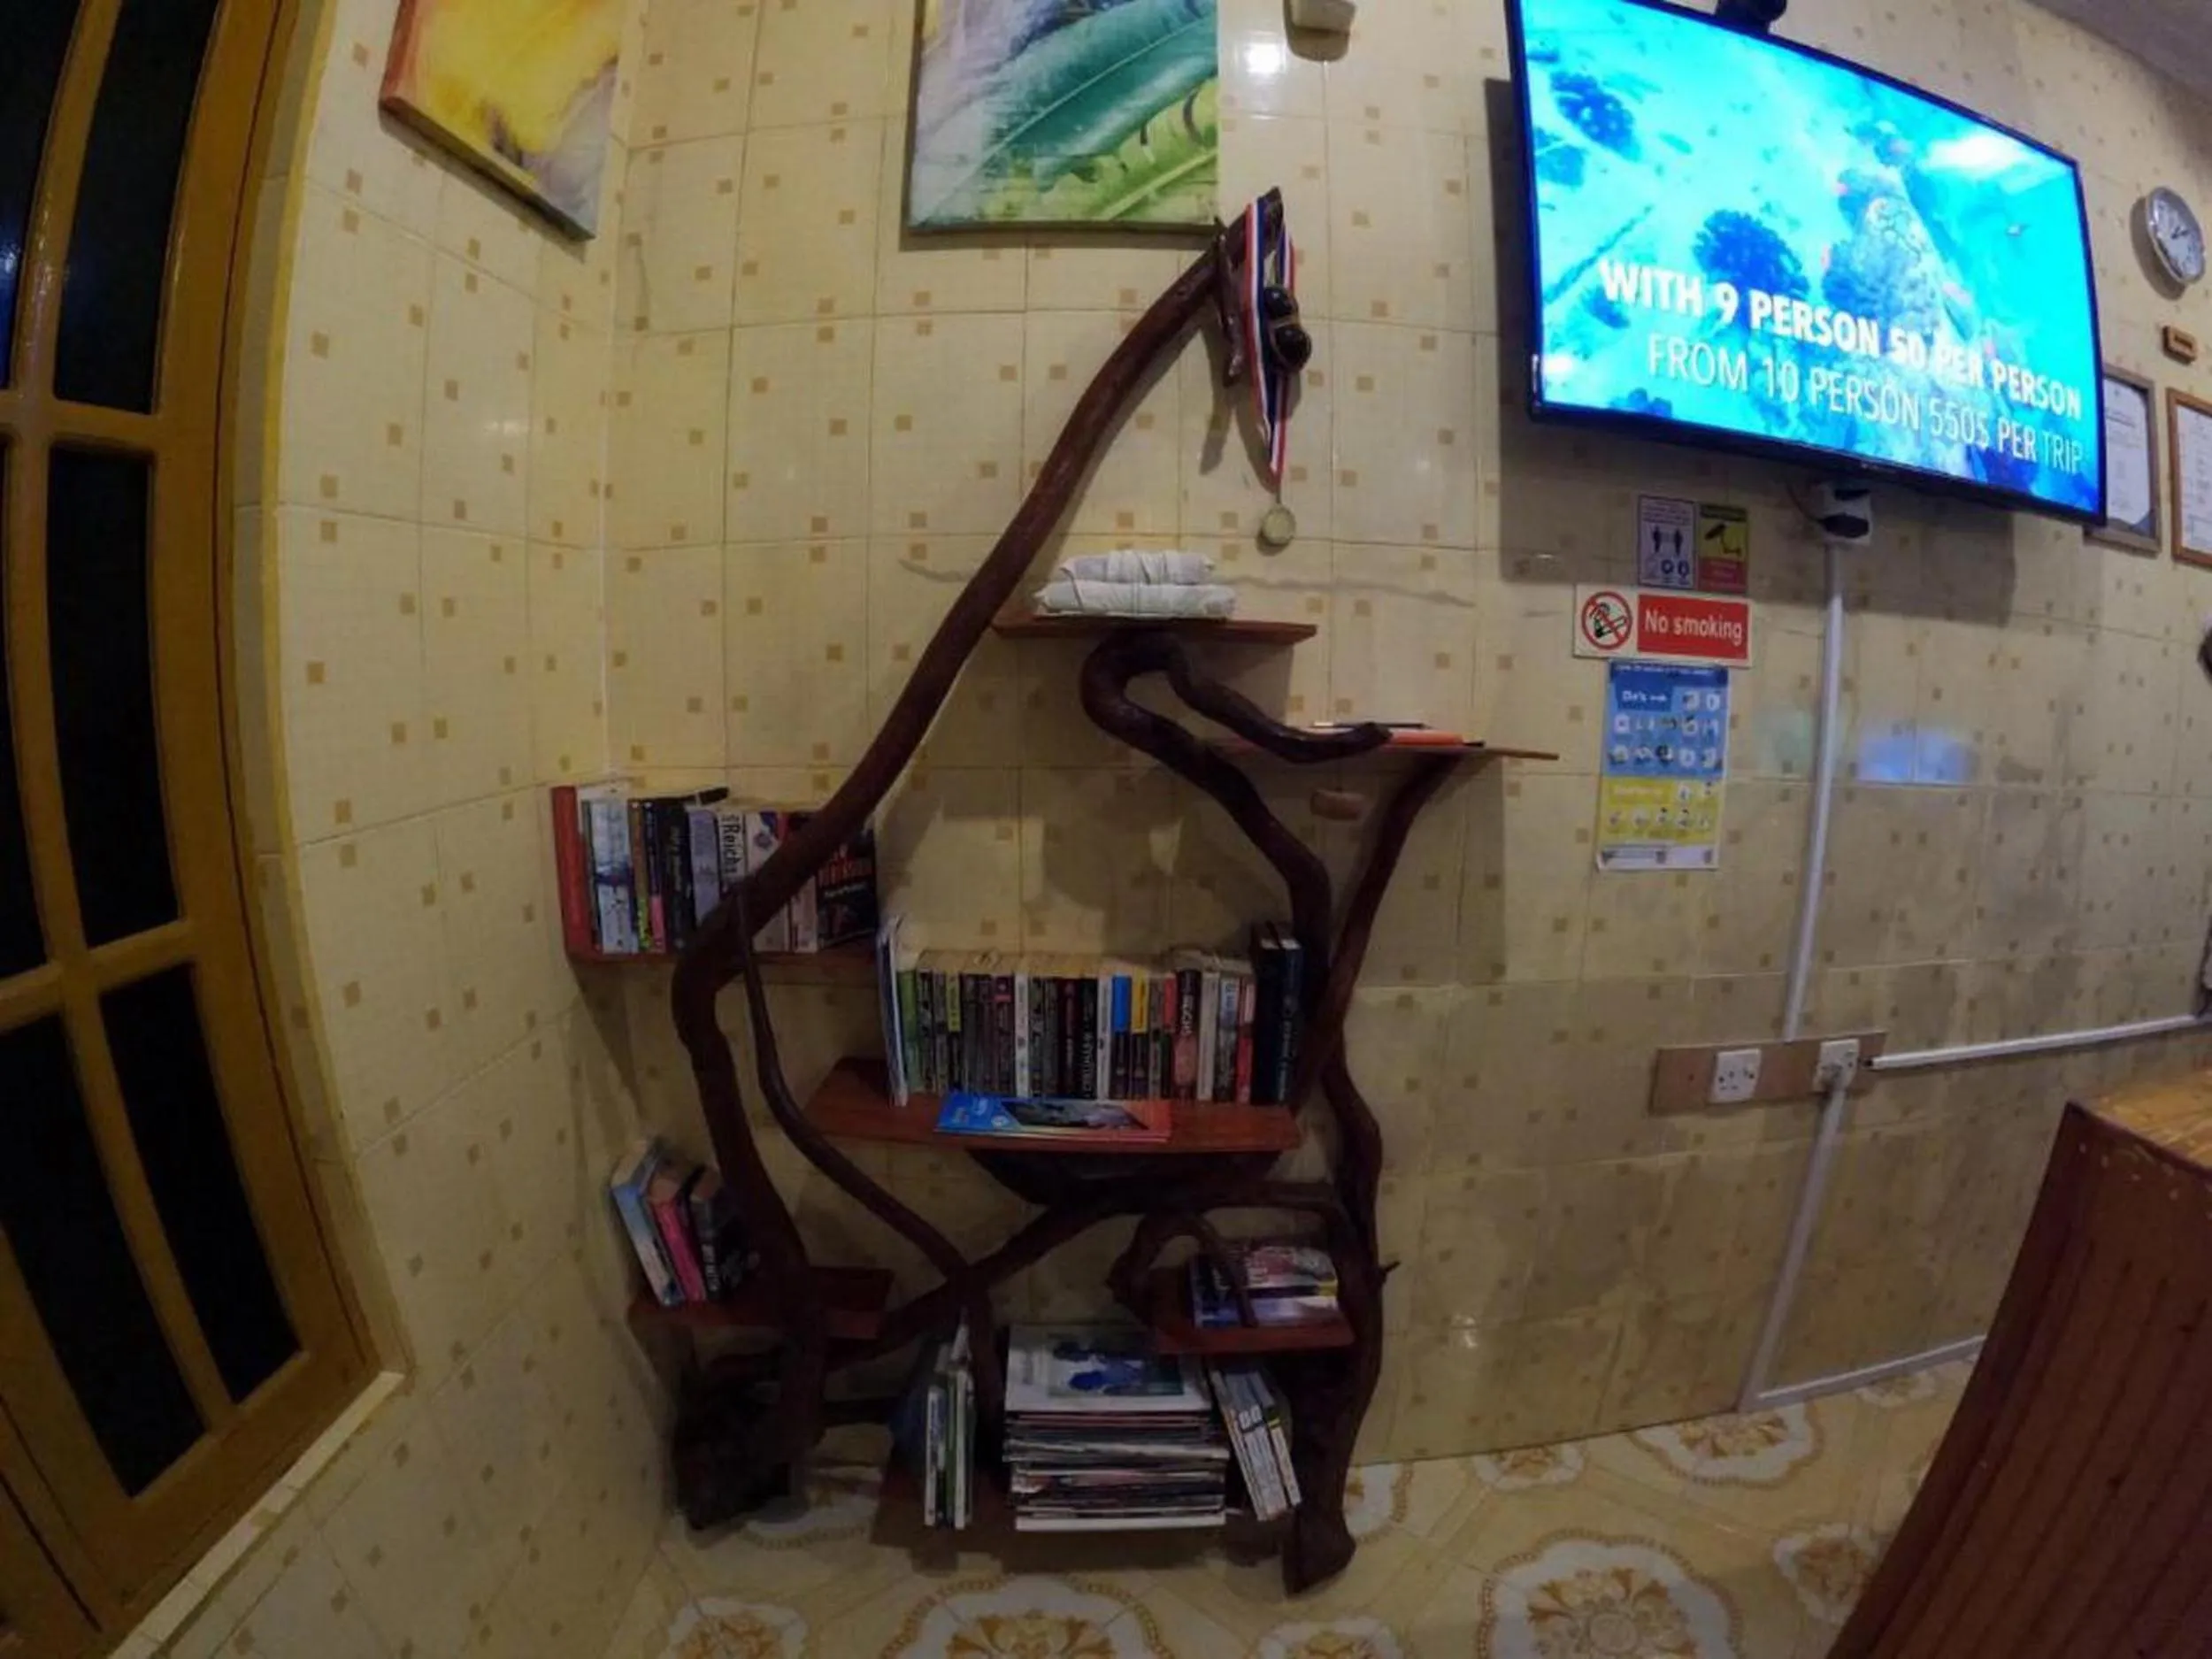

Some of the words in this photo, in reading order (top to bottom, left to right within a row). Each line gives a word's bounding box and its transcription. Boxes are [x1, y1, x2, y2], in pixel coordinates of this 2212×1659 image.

[1597, 259, 1703, 317] WITH
[1713, 281, 1740, 325] 9
[1748, 288, 1881, 358] PERSON
[1933, 342, 1985, 388] PER
[1991, 358, 2083, 420] PERSON
[1647, 332, 1748, 392] FROM
[1762, 356, 1801, 403] 10
[1809, 365, 1921, 431] PERSON
[1997, 417, 2038, 463] PER
[2041, 431, 2085, 474] TRIP
[1645, 608, 1670, 634] No
[1672, 614, 1743, 647] smoking
